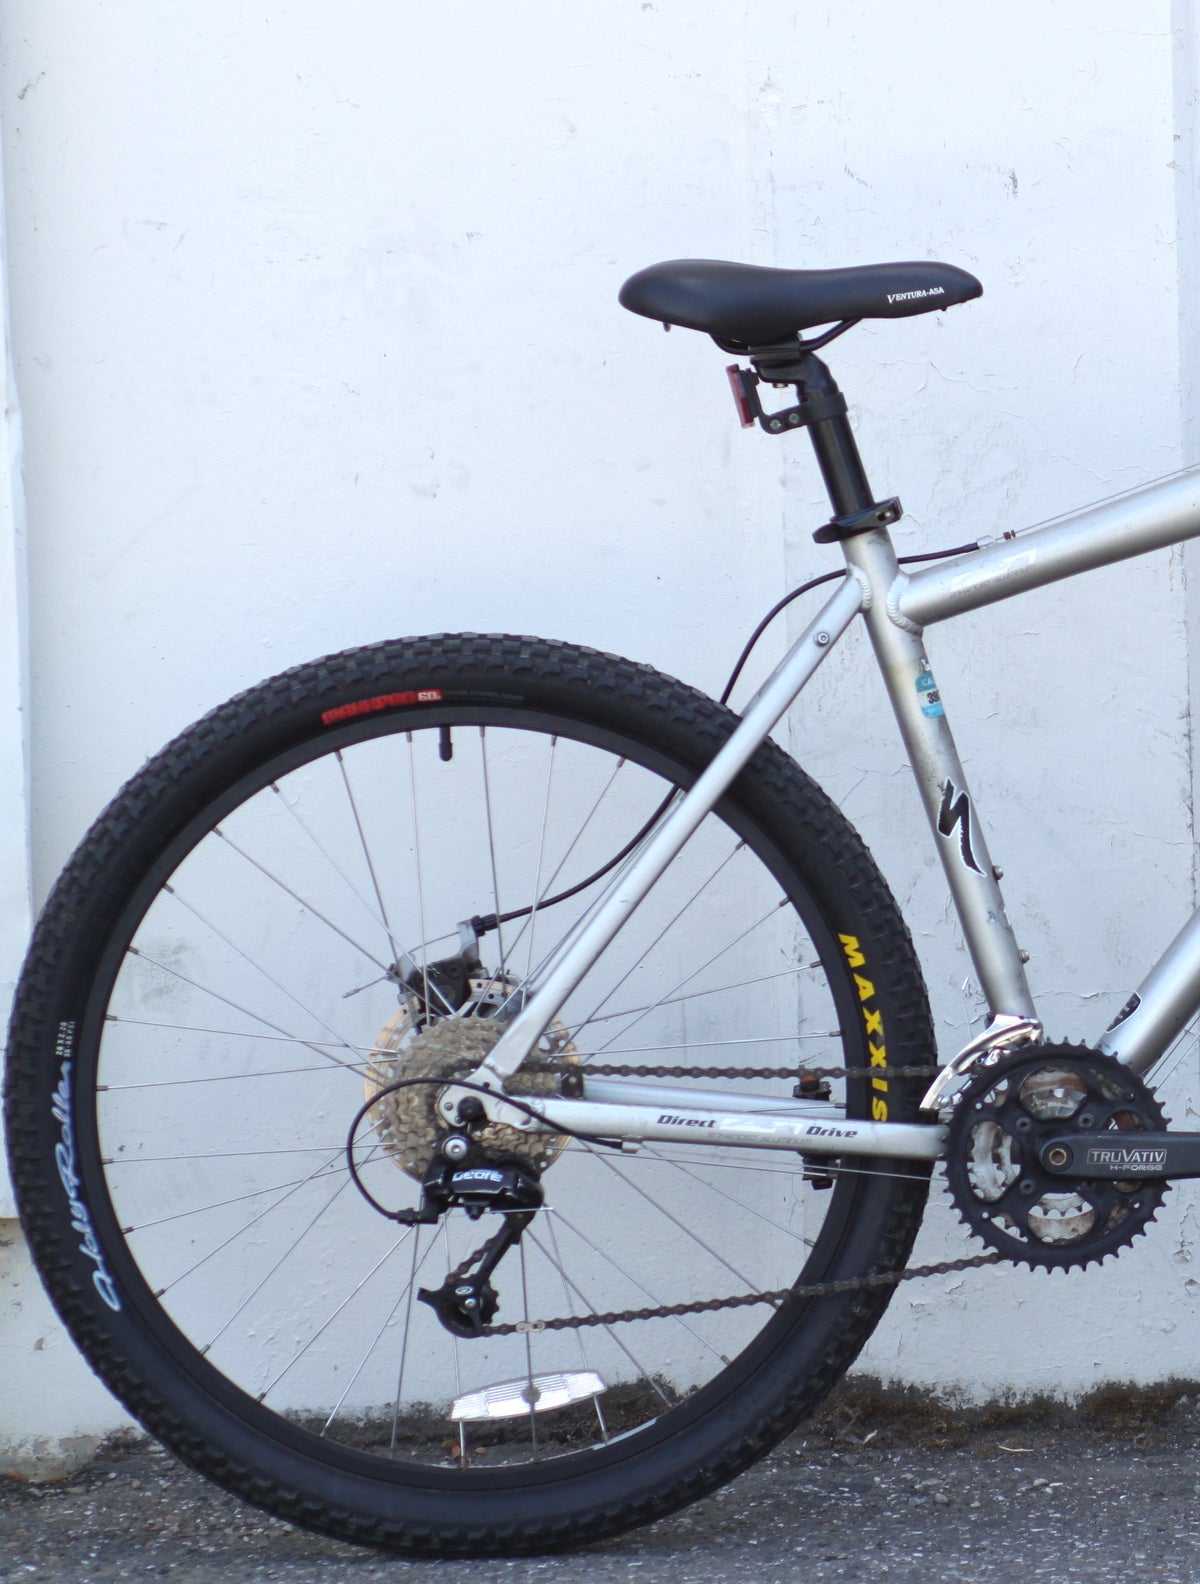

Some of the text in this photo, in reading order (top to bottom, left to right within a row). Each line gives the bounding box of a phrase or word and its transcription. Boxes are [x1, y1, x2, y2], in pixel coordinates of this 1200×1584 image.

[886, 286, 945, 305] VENTURA-ASA
[837, 932, 889, 1122] MAXXIS
[657, 1114, 858, 1138] Direct Drive
[1091, 1149, 1165, 1163] TRUVATIV
